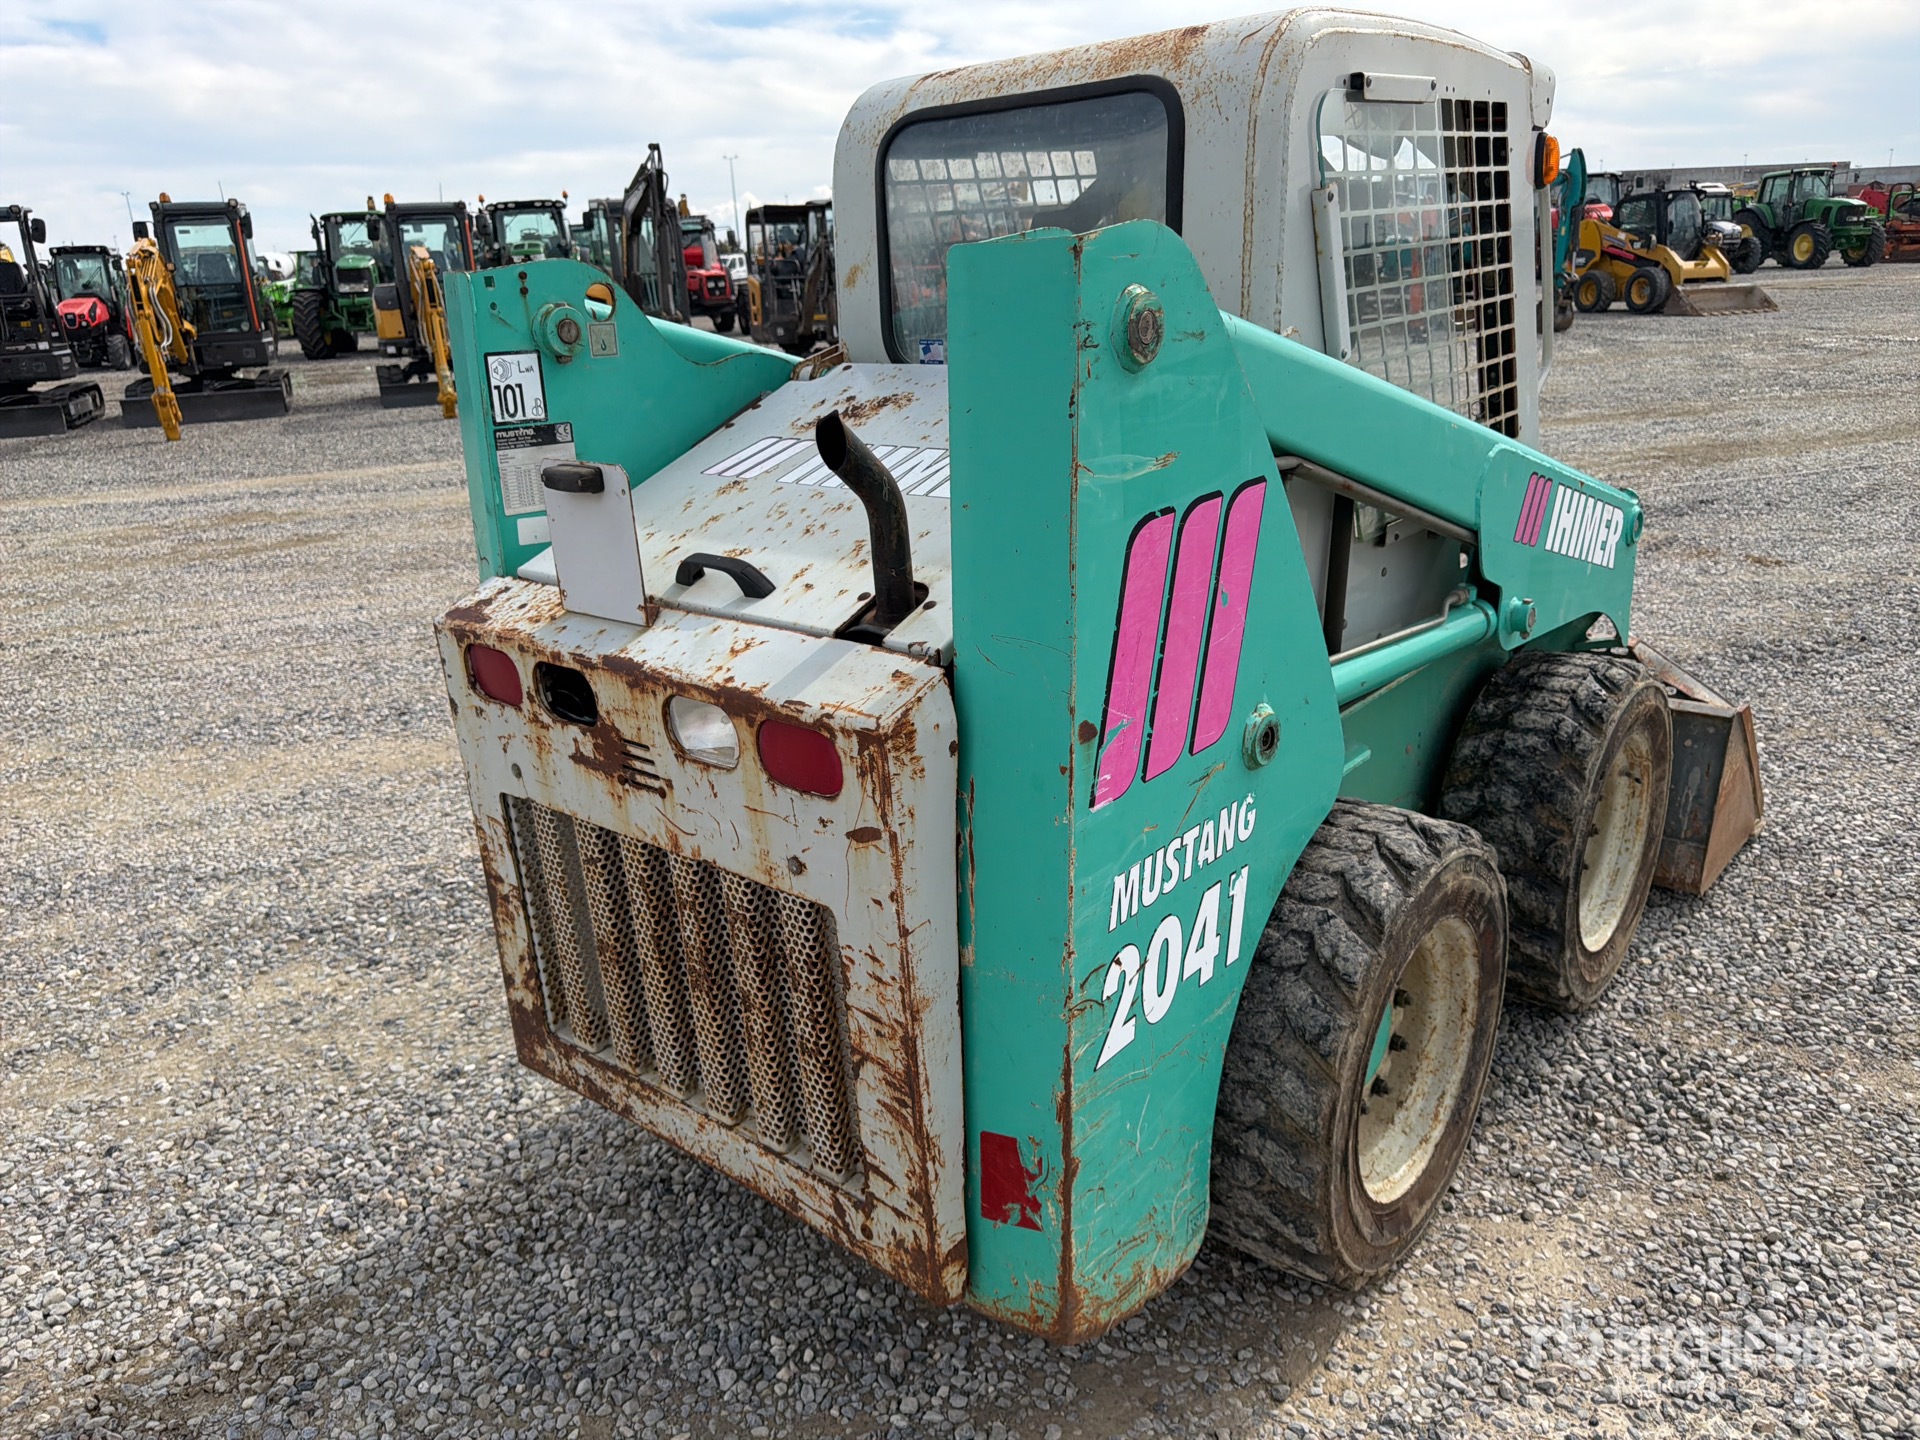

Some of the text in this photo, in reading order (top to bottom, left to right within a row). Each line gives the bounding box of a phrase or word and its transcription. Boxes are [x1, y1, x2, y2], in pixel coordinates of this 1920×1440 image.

[493, 383, 526, 420] 101
[1544, 483, 1625, 570] IHIMER
[1108, 794, 1257, 933] MUSTANG
[1094, 864, 1250, 1072] 2041
